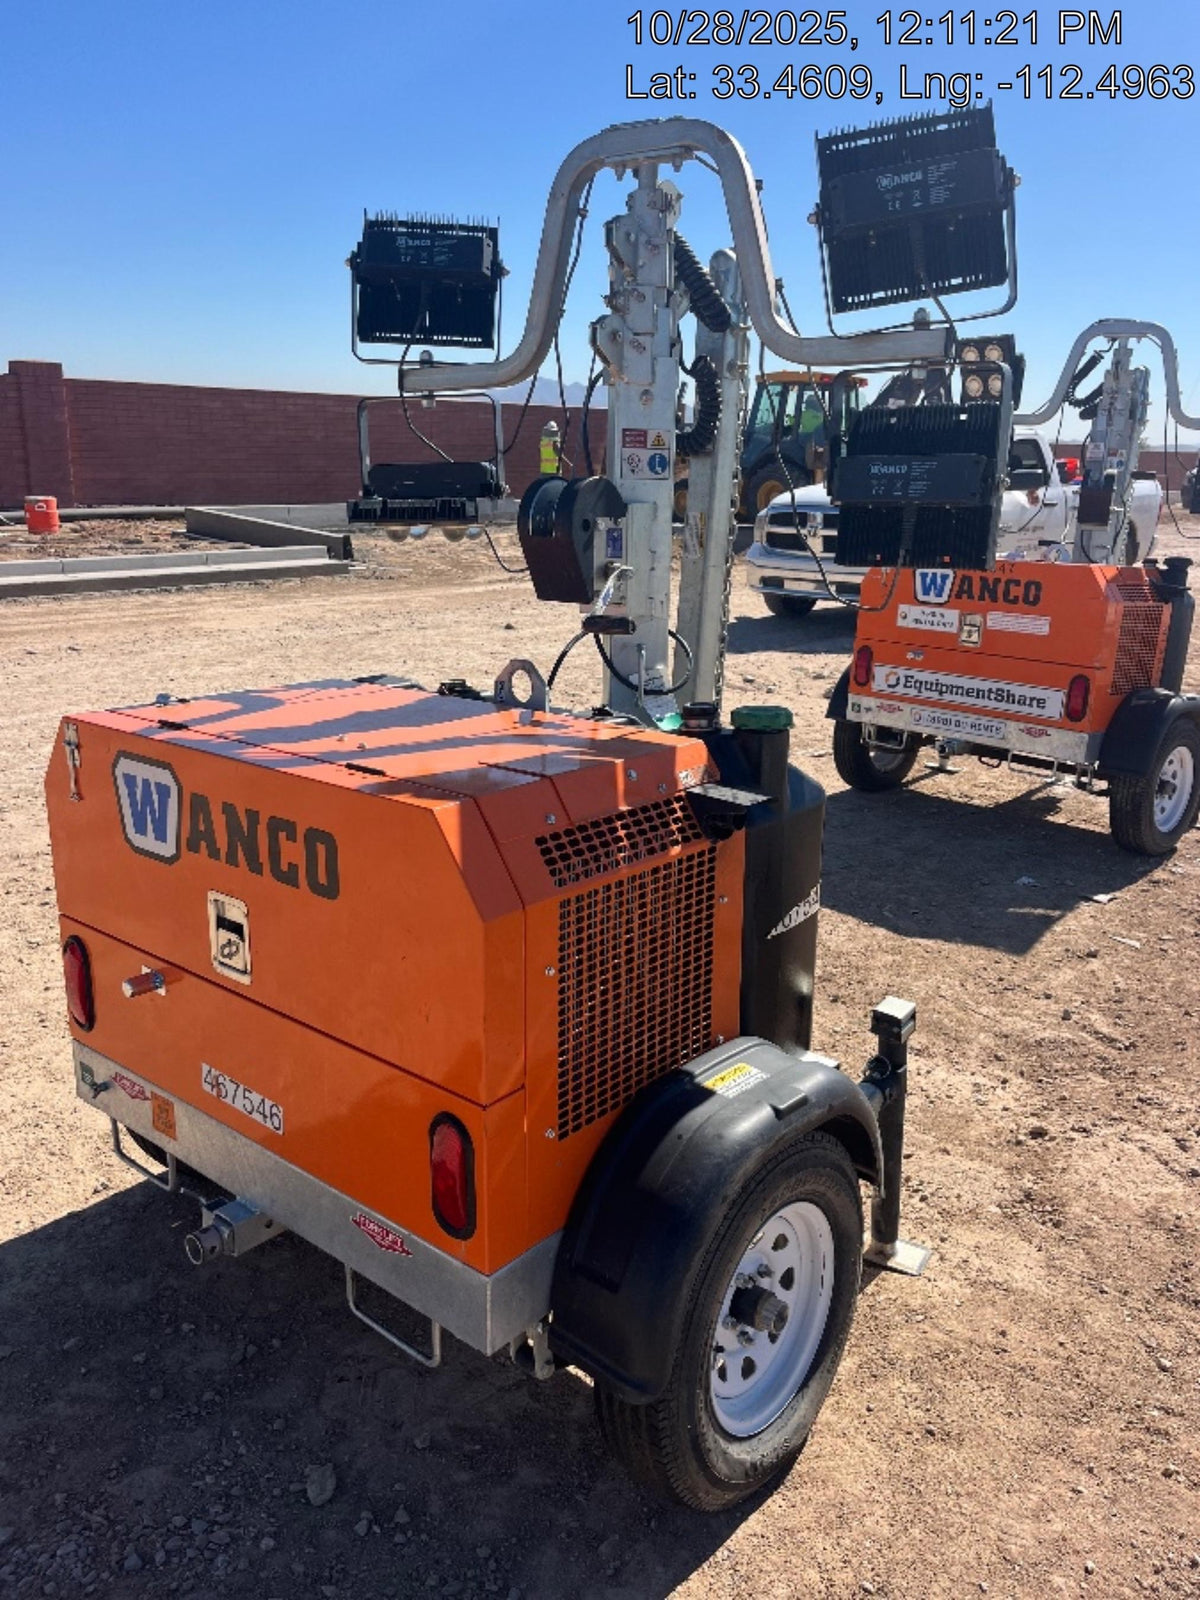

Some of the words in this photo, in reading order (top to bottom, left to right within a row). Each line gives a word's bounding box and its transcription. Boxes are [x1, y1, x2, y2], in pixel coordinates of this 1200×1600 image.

[918, 570, 1043, 607] WANCO
[902, 674, 1047, 711] EquipmentShare
[120, 771, 340, 901] WANCO
[203, 1066, 282, 1132] 467546
